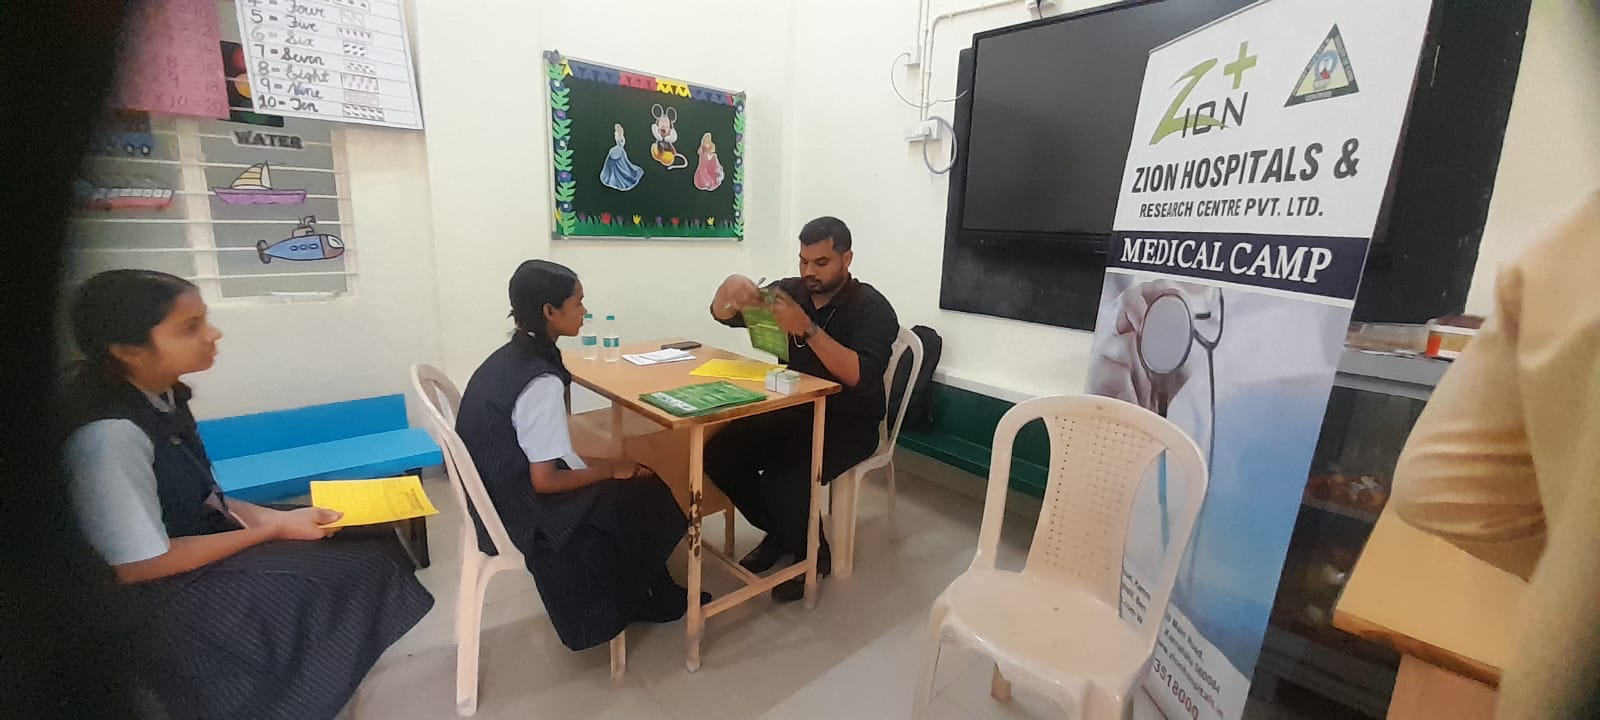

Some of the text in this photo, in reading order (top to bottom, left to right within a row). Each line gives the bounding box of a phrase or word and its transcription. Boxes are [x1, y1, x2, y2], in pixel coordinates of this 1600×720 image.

[250, 9, 264, 24] 5
[251, 26, 265, 40] 6
[254, 43, 265, 58] 7
[280, 47, 325, 66] Seven
[258, 61, 270, 76] 8
[260, 77, 271, 93] 9
[259, 94, 277, 109] 10
[234, 130, 304, 149] WATER
[1132, 137, 1360, 194] ZION HOSPITALS &
[1139, 196, 1324, 219] RESEARCH CENTRE PVT. LTD.
[1120, 237, 1333, 284] MEDICAL CAMP
